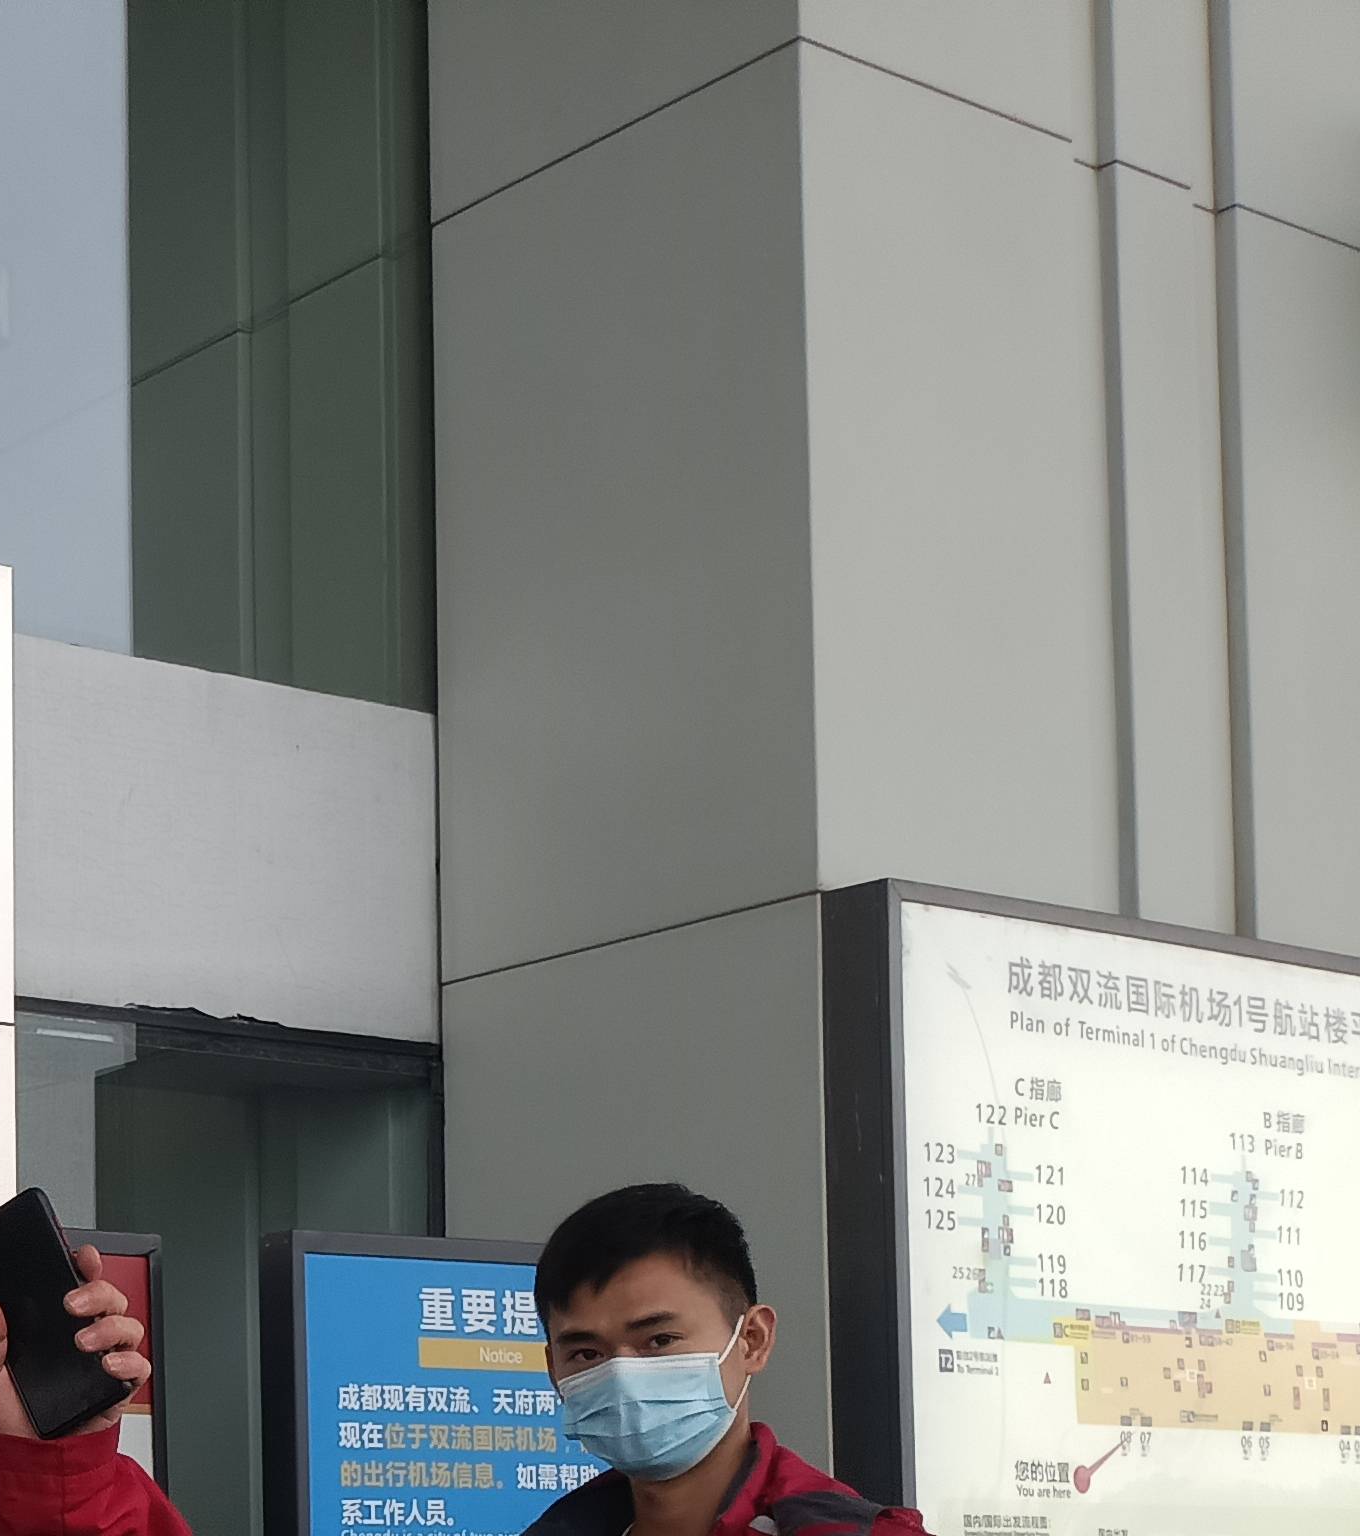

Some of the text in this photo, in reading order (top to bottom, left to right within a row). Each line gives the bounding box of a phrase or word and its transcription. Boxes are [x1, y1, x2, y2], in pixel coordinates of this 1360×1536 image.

[1010, 1011, 1324, 1077] Plan of Terminal of Chengdu Shuangliu
[1015, 1078, 1025, 1097] C
[976, 1103, 1007, 1125] 122
[1014, 1107, 1060, 1130] Pier C
[1263, 1112, 1272, 1129] B
[924, 1142, 955, 1164] 123
[1229, 1133, 1254, 1153] 113
[1265, 1139, 1303, 1160] Pier B
[1035, 1164, 1064, 1186] 121
[1181, 1165, 1208, 1186] 114
[923, 1176, 956, 1199] 124
[1180, 1199, 1207, 1219] 115
[1280, 1189, 1304, 1209] 112
[925, 1209, 956, 1231] 125
[1036, 1204, 1066, 1226] 120
[1179, 1230, 1207, 1251] 116
[1278, 1226, 1301, 1246] 111
[1038, 1253, 1067, 1275] 119
[1178, 1264, 1206, 1284] 117
[1038, 1278, 1068, 1299] 118
[1278, 1268, 1304, 1288] 110
[1278, 1292, 1304, 1312] 109
[479, 1347, 523, 1365] Notice
[1015, 1460, 1070, 1483] 您的位置
[1016, 1485, 1072, 1499] You are here
[341, 1498, 455, 1527] 系工作人员。
